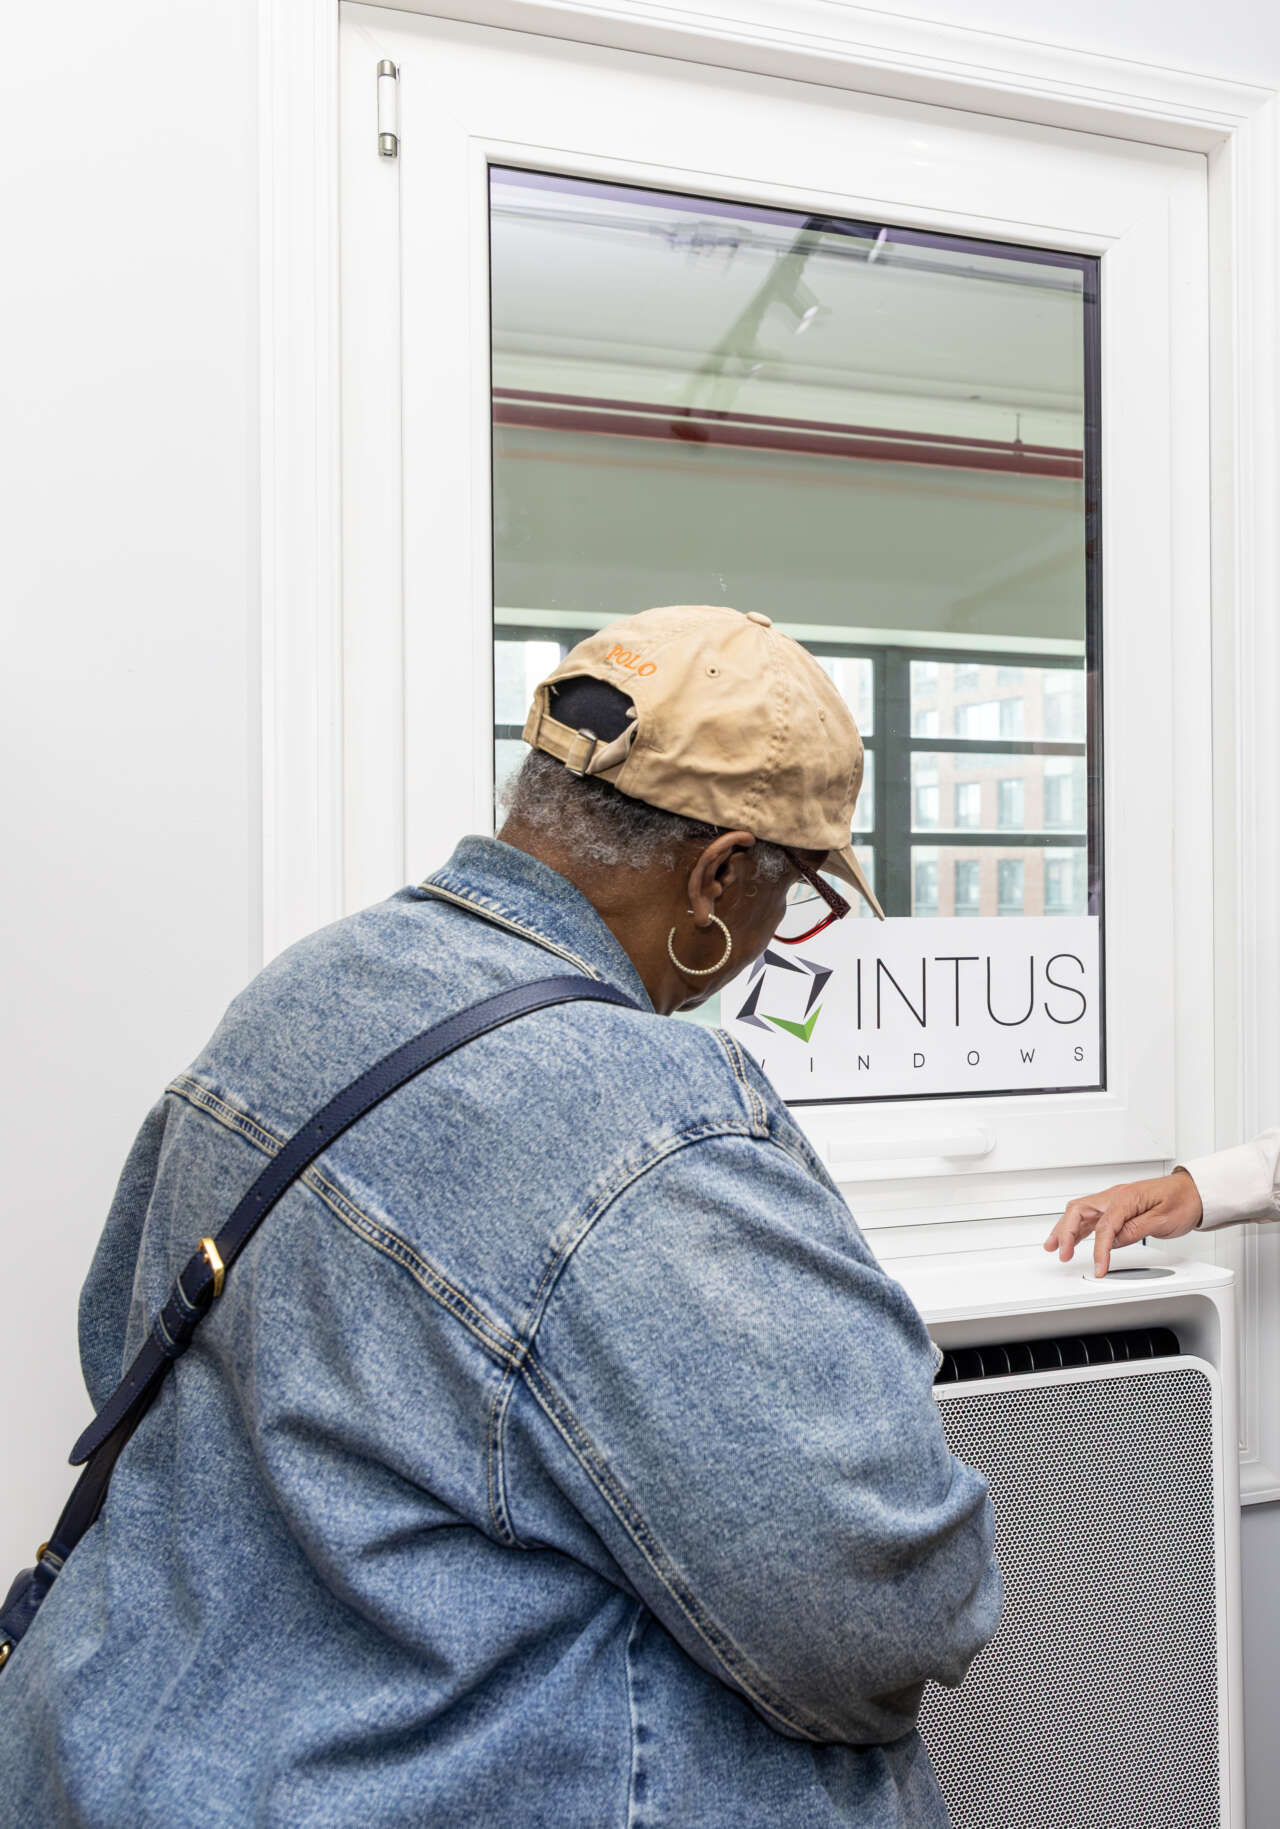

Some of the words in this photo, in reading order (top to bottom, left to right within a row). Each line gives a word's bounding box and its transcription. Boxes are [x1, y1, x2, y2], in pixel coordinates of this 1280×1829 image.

[606, 645, 657, 677] POLO
[857, 953, 1087, 1030] INTUS
[760, 1046, 1085, 1073] INDOWS
